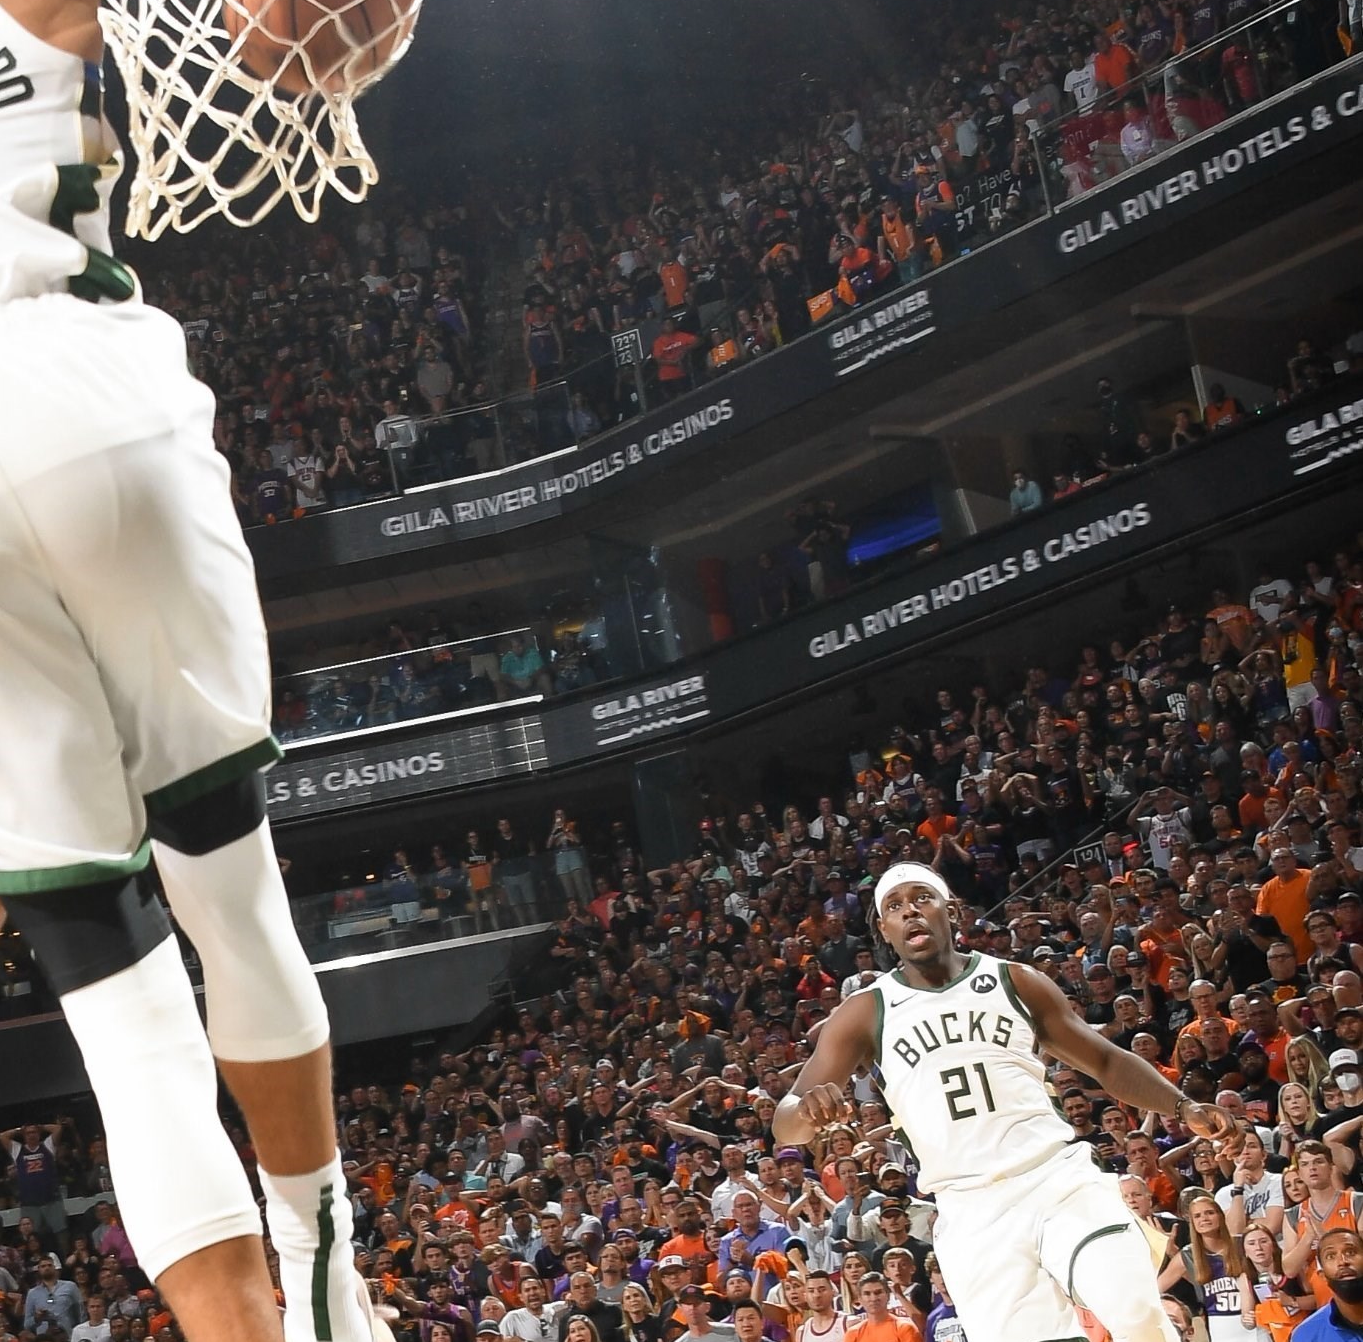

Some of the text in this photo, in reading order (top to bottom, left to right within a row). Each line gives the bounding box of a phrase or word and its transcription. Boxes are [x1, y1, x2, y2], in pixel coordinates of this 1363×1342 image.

[1059, 106, 1334, 254] GILA RIVER HOTELS &
[830, 290, 930, 349] GILA RIVER
[381, 399, 734, 536] GILA RIVER HOTELS & CASINOS
[809, 503, 1152, 658] GILA RIVER HOTELS & CASINOS
[591, 675, 705, 722] GILA RIVER
[296, 775, 317, 797] &
[322, 752, 445, 792] CASINOS
[893, 1011, 1014, 1069] BUCKS
[940, 1062, 996, 1121] 21
